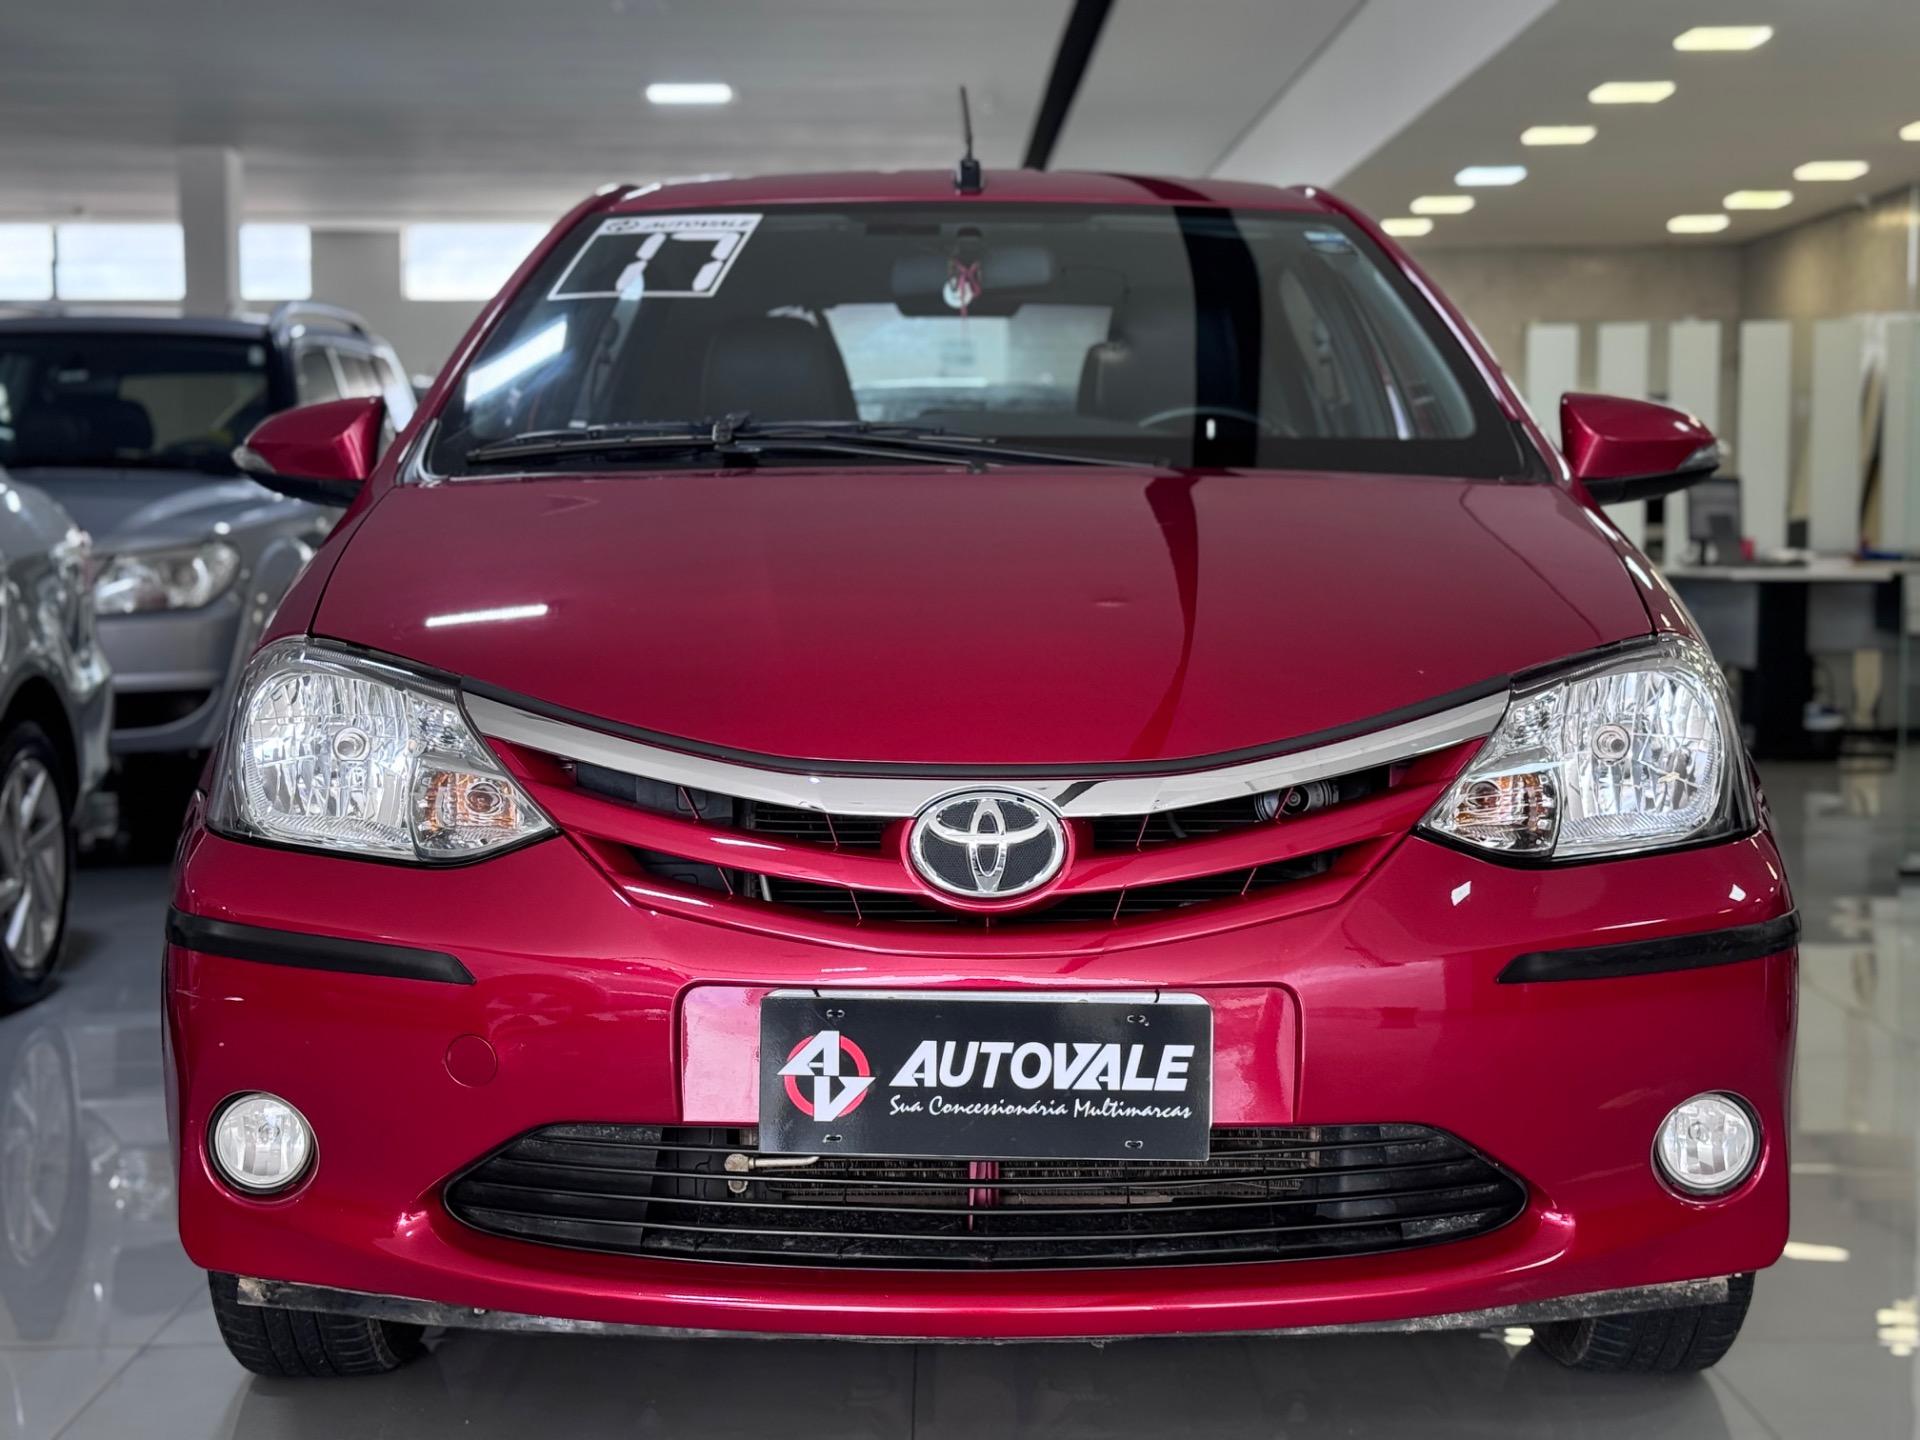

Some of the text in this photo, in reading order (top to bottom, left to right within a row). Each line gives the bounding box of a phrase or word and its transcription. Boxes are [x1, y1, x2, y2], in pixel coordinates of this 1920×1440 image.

[888, 1040, 1196, 1092] AUTOVALE
[888, 1095, 1194, 1120] Sua Concessionária Multimarcas
